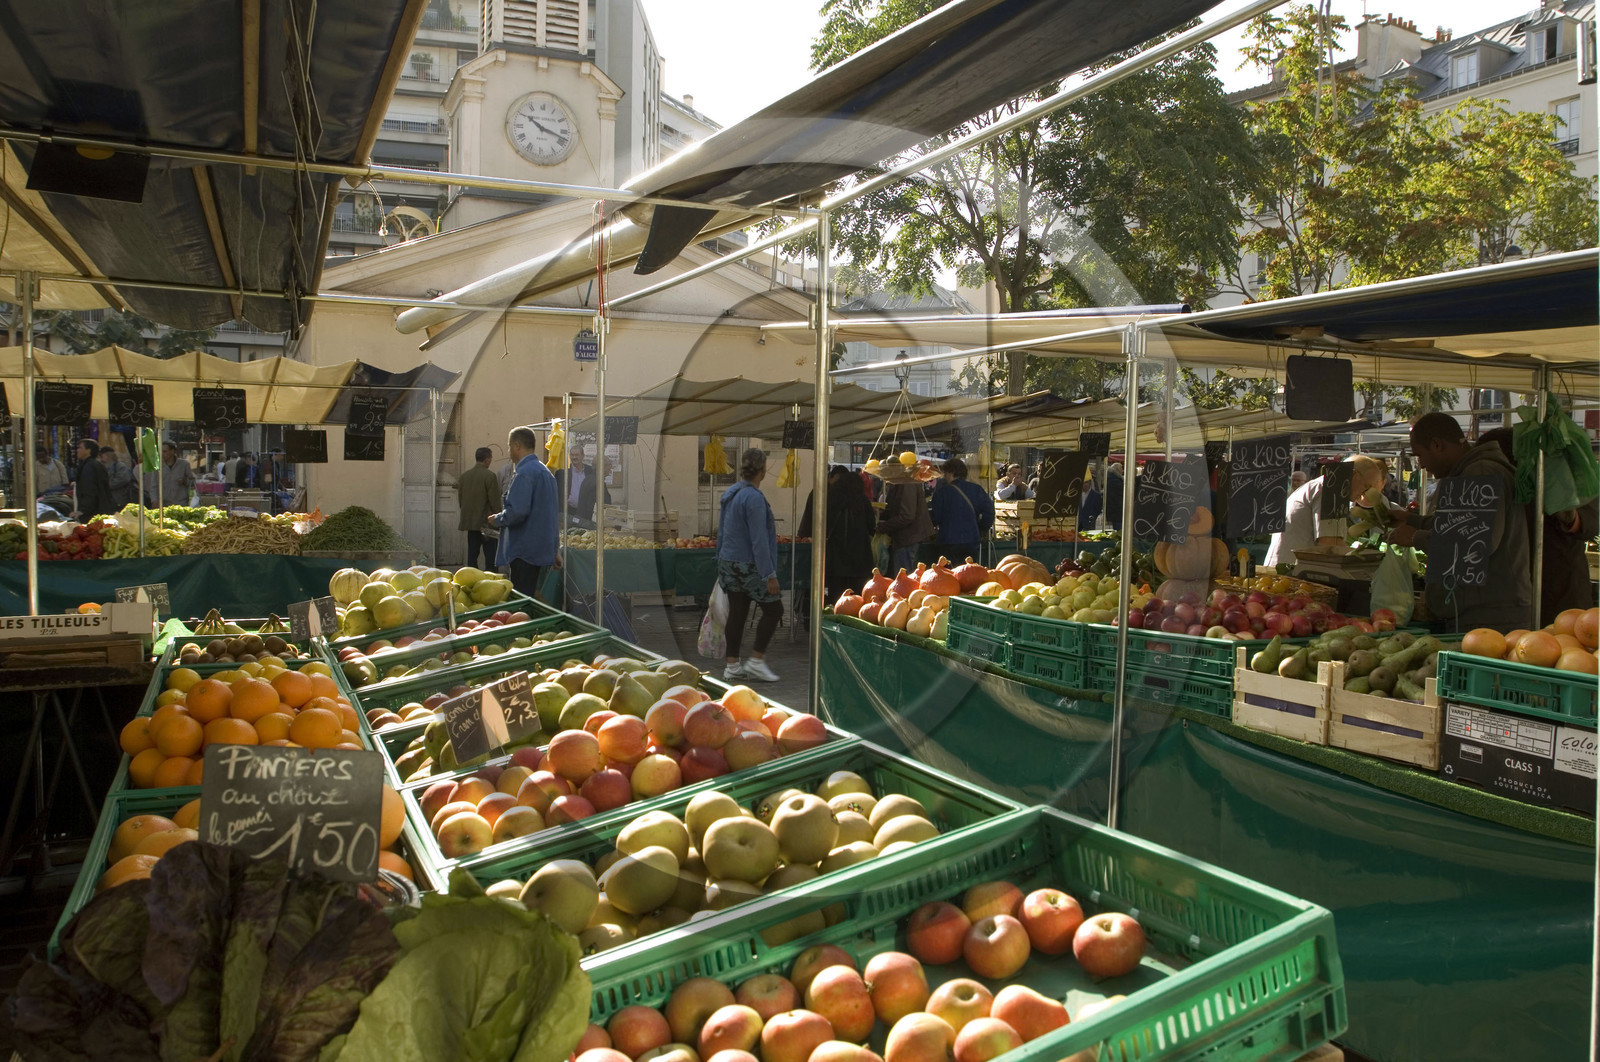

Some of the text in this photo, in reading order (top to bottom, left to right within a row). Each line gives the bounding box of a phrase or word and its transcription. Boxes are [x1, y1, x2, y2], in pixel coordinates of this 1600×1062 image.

[1450, 709, 1471, 718] VARIETY
[1504, 758, 1541, 775] CLASS 1
[1493, 780, 1552, 800] SOUTH AFRICA
[1498, 776, 1534, 790] PRODUCE
